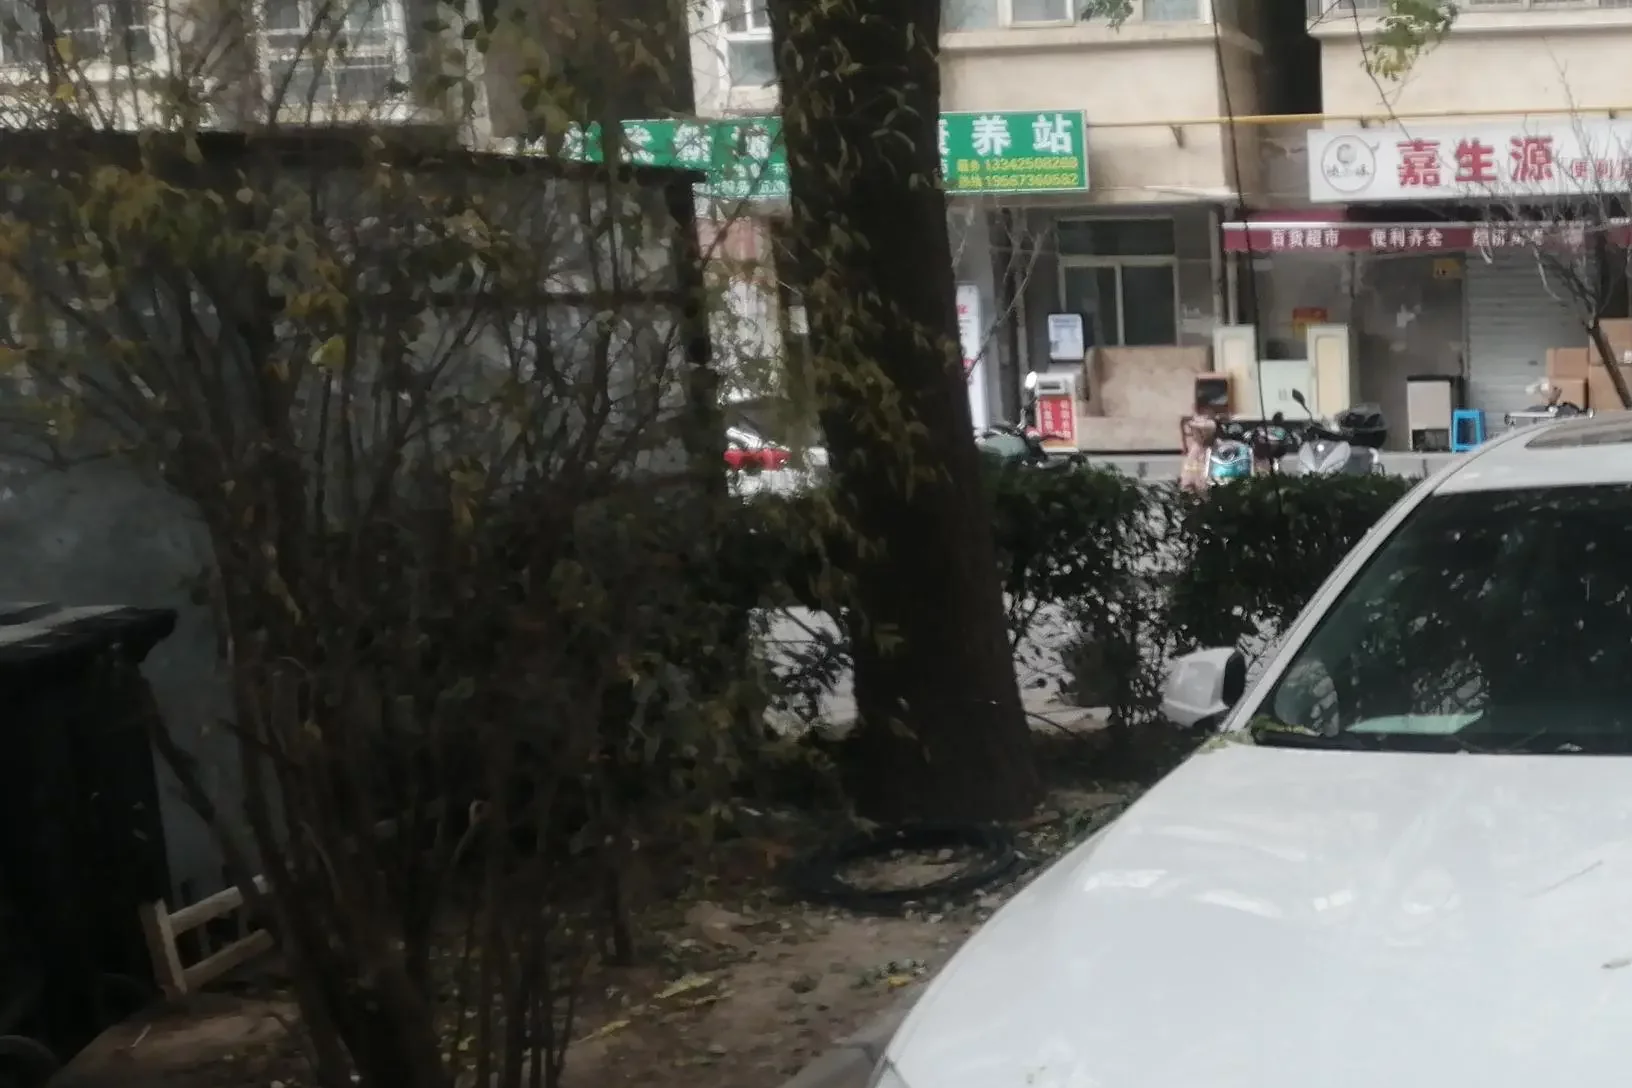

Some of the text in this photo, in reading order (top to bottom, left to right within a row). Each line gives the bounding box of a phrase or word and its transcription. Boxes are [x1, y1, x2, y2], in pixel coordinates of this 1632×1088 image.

[1397, 136, 1554, 187] 嘉生源
[1370, 228, 1443, 248] 便利齐全
